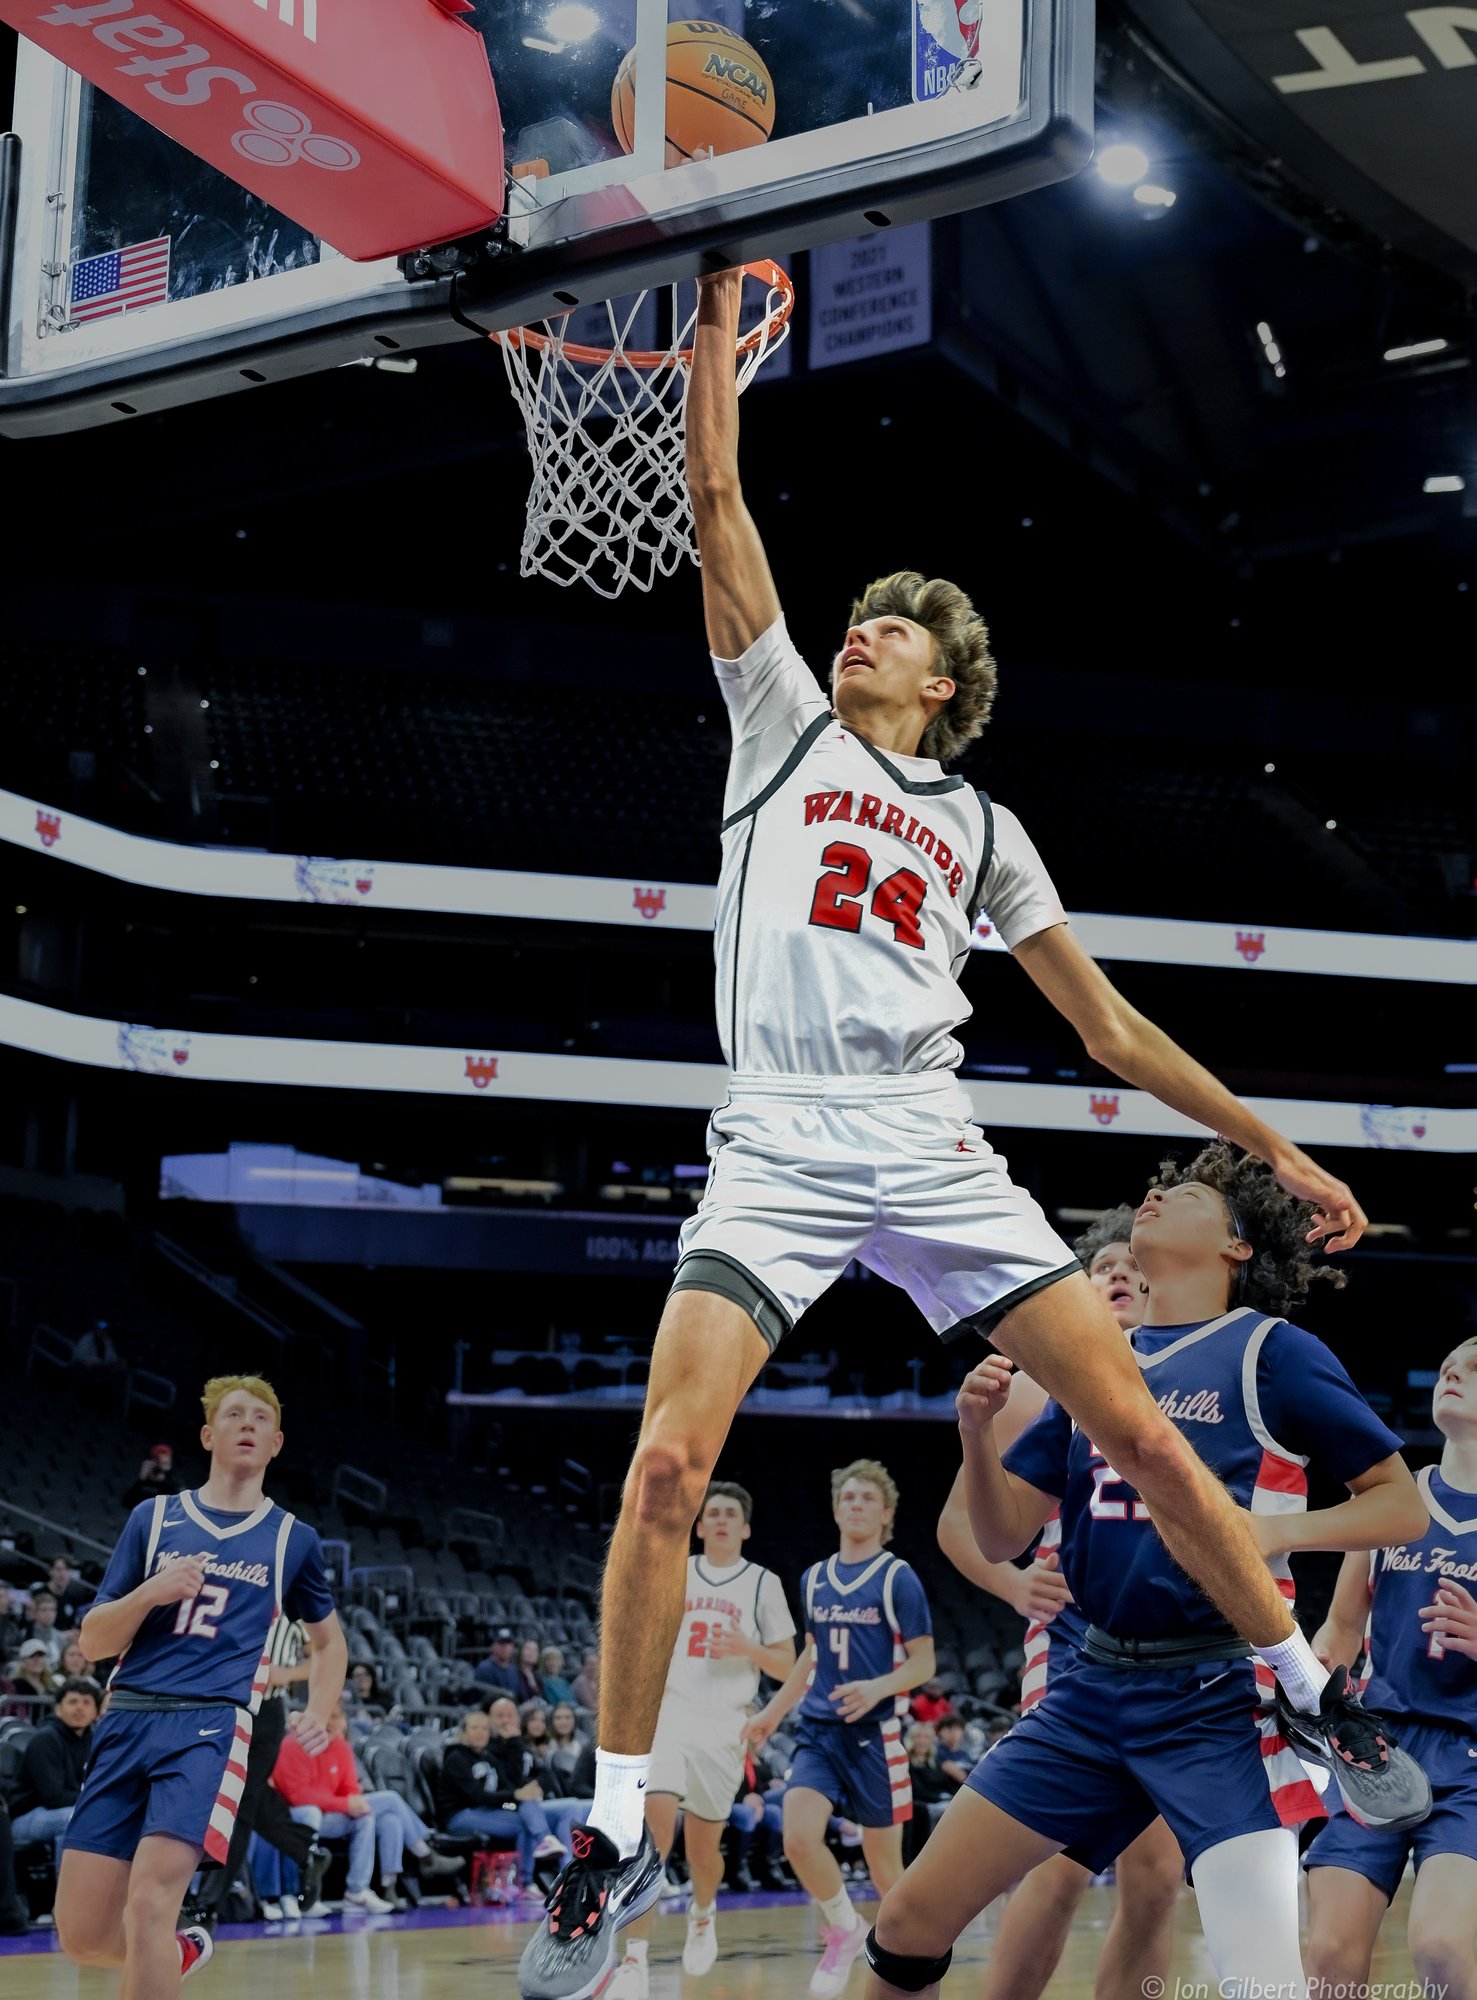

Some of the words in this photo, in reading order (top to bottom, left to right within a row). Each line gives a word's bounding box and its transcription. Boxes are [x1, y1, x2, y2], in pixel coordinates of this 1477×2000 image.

[703, 52, 768, 105] NCAA
[808, 840, 928, 951] 24
[1381, 1546, 1423, 1573] West
[172, 1583, 231, 1640] 12
[829, 1627, 850, 1671] 4
